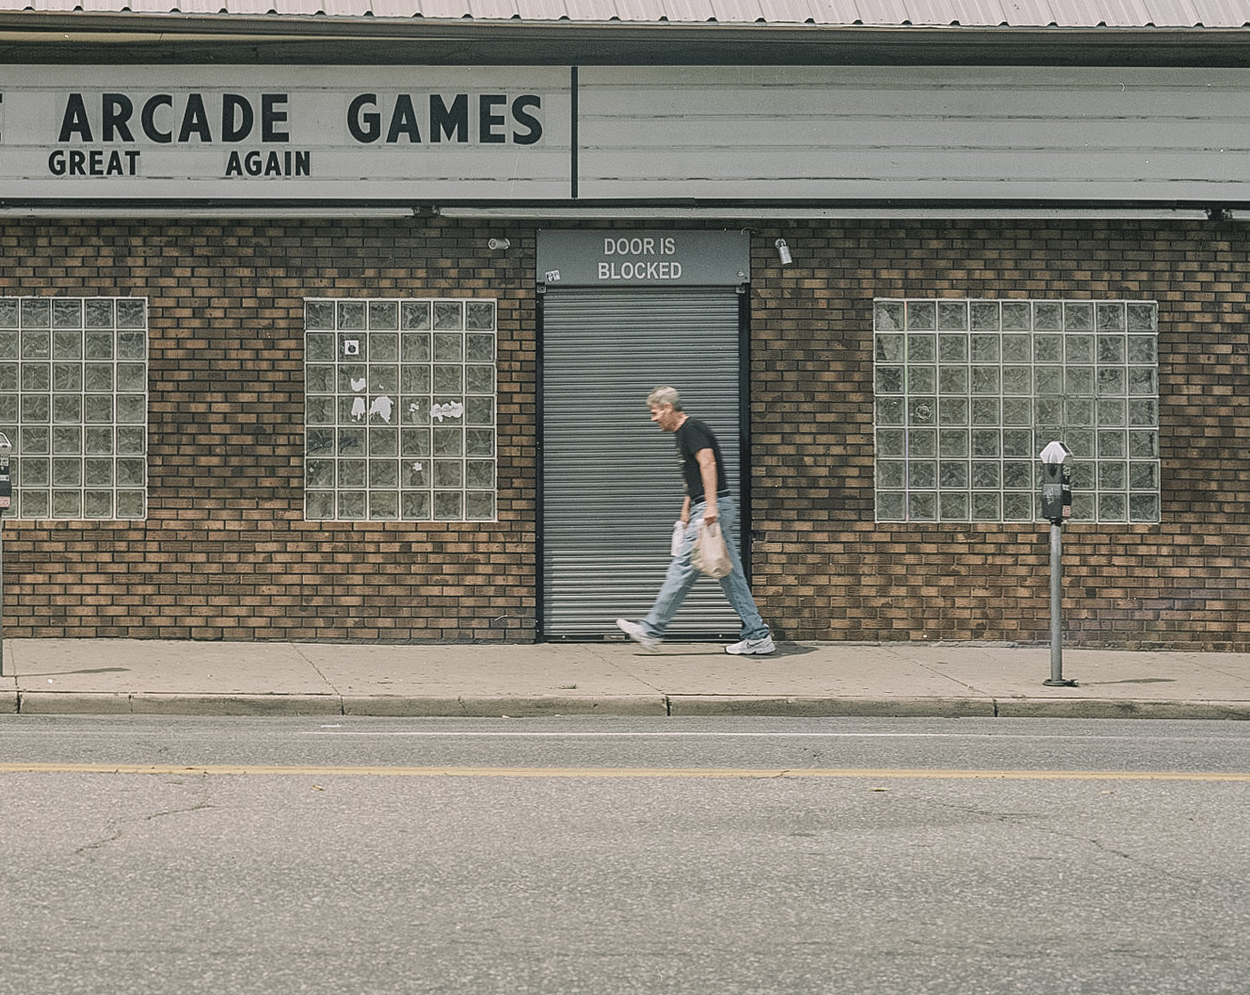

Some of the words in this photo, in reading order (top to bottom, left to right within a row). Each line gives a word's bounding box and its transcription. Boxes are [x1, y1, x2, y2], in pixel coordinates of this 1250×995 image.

[59, 93, 290, 144] ARCADE
[347, 94, 543, 145] GAMES
[48, 150, 141, 176] GREAT
[225, 151, 311, 176] AGAIN
[604, 238, 654, 254] DOOR
[660, 238, 675, 254] IS
[598, 262, 682, 279] BLOCKED
